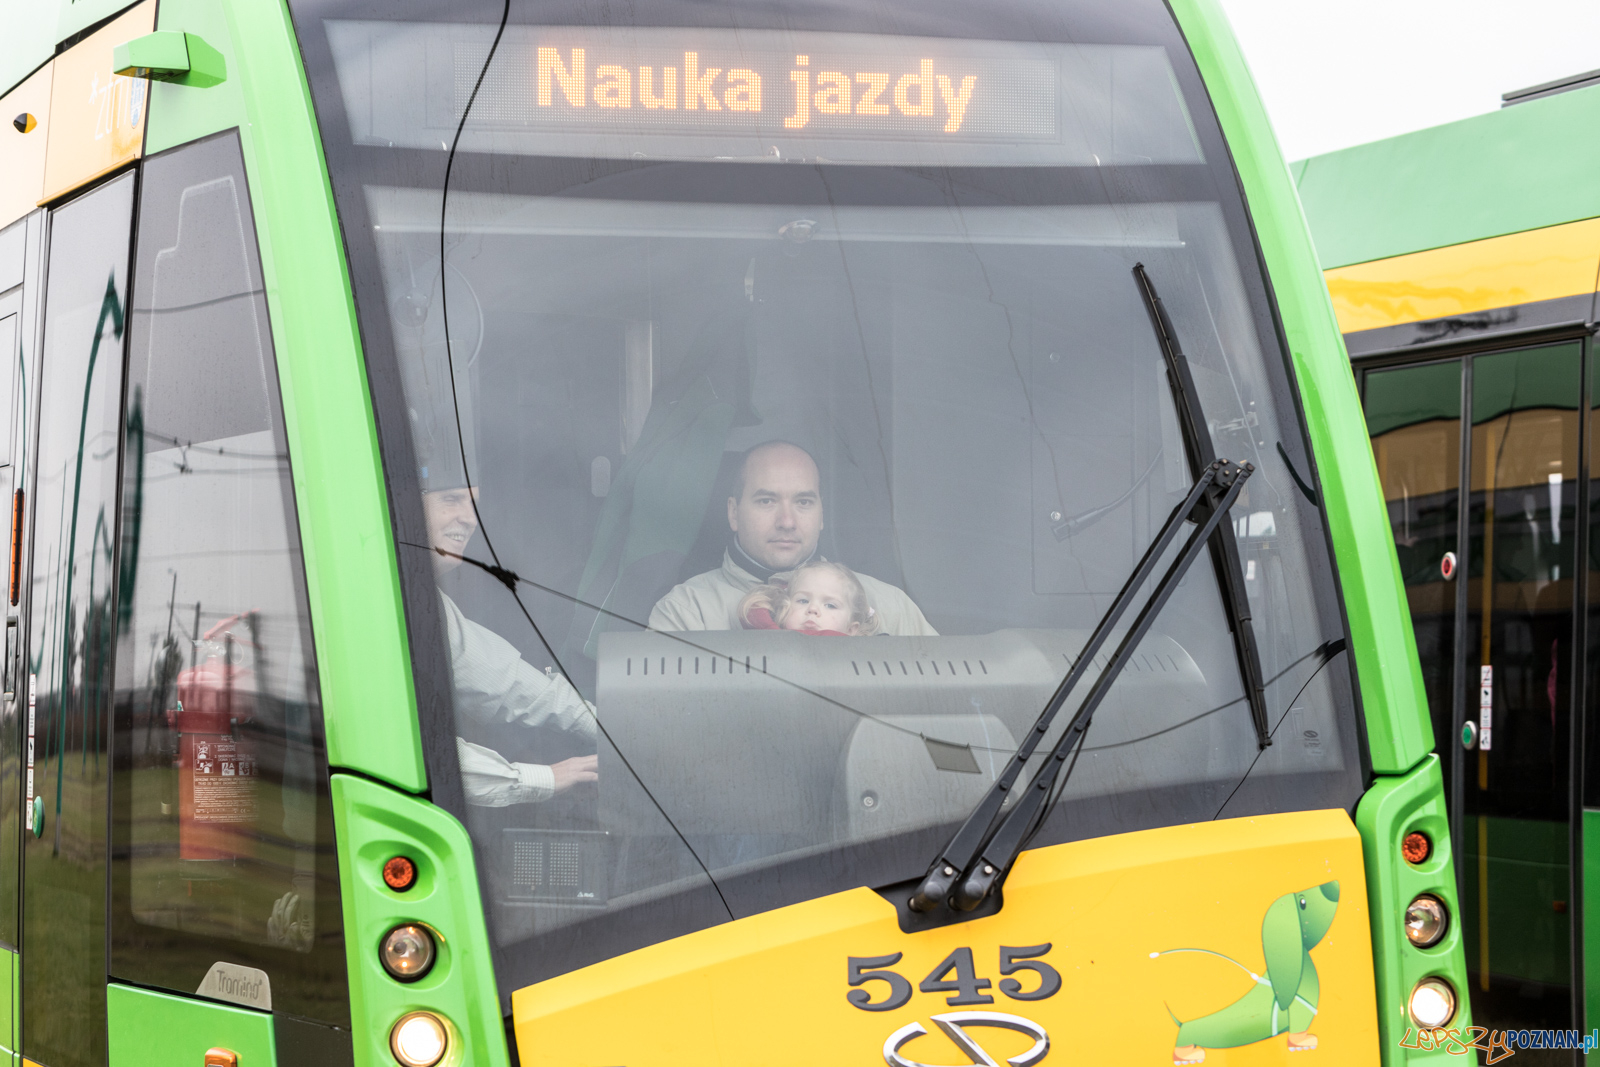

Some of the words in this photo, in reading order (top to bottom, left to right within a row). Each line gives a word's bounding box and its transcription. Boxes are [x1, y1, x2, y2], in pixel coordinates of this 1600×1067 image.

[537, 47, 762, 112] Nauka
[784, 55, 977, 132] jazdy
[846, 942, 1062, 1012] 545
